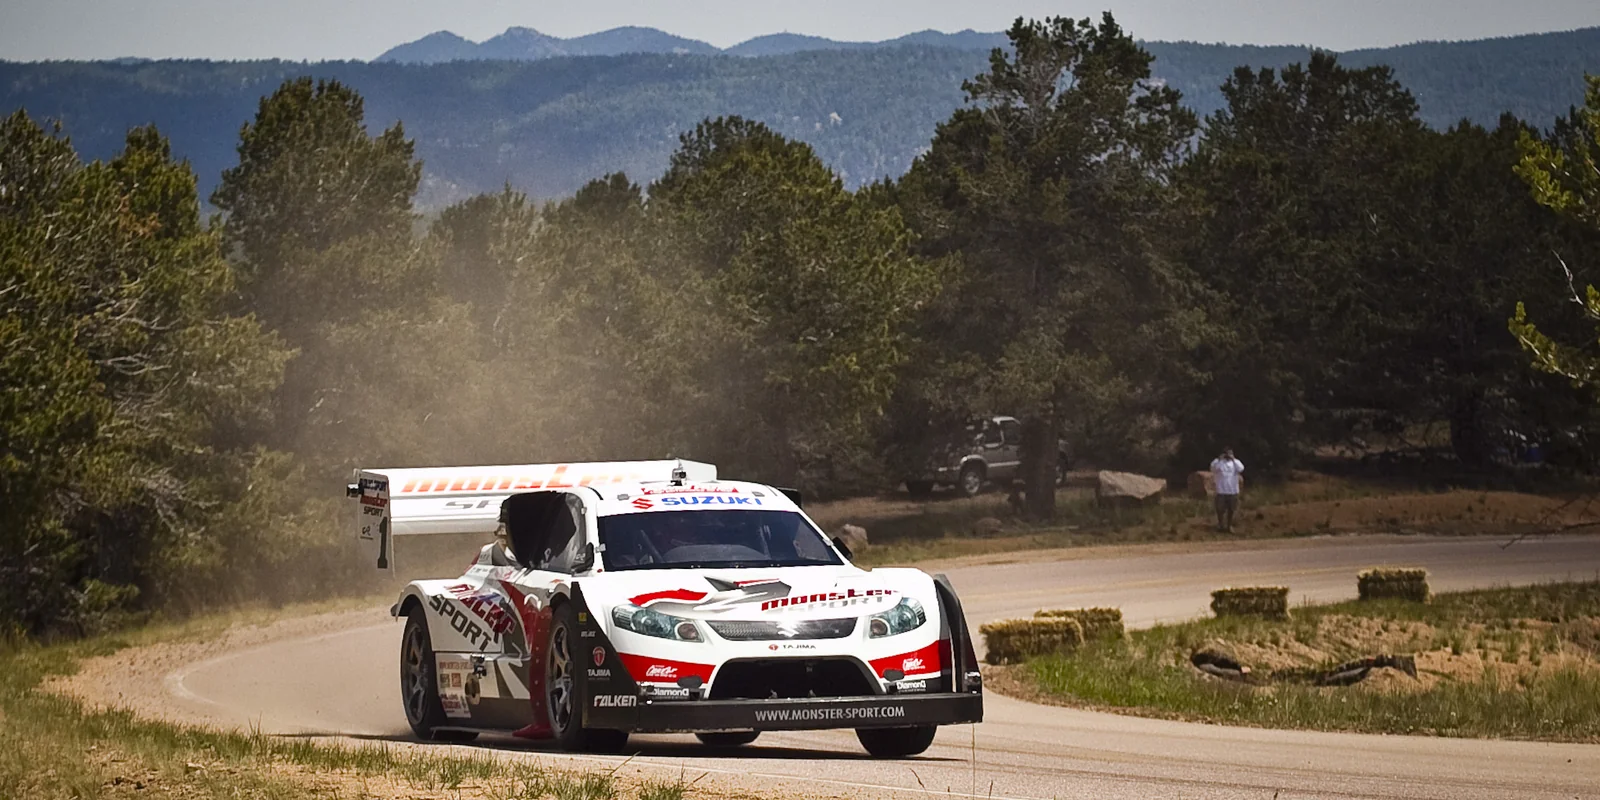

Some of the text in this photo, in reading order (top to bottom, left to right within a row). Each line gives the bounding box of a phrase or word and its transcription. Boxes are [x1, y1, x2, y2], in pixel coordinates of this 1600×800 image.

[661, 496, 762, 505] SUZUKI
[364, 506, 384, 518] SPORT
[761, 589, 899, 611] monster
[428, 594, 502, 652] SPORT
[587, 669, 611, 677] TAJIMA
[594, 695, 637, 707] FALKEN
[755, 706, 905, 722] WWW.MONSTER-SPORT.COM
